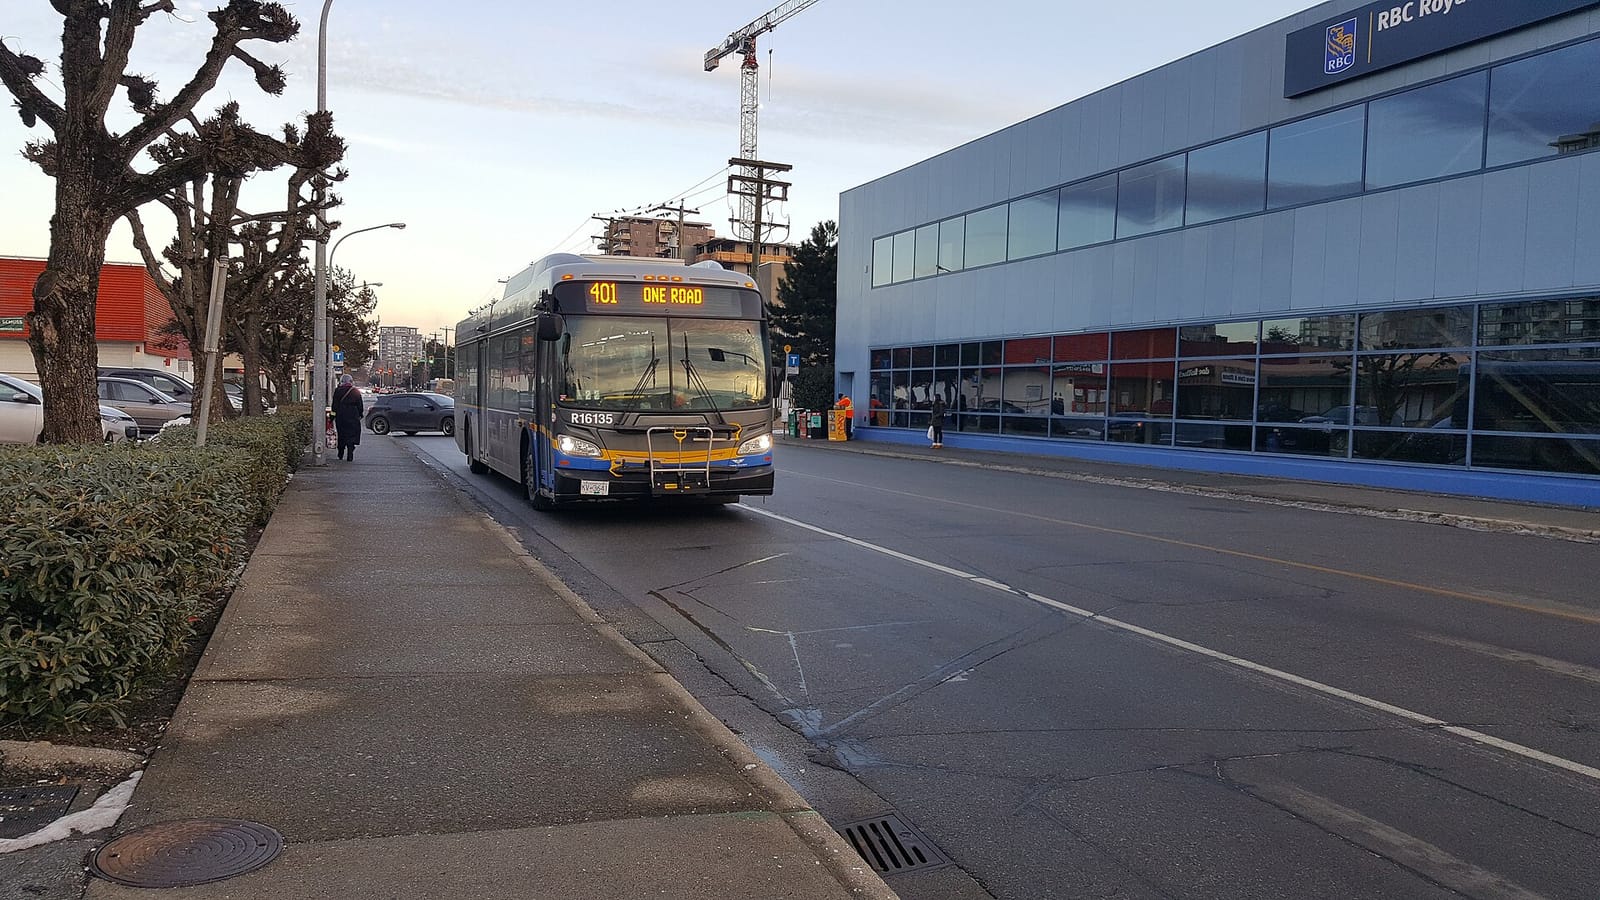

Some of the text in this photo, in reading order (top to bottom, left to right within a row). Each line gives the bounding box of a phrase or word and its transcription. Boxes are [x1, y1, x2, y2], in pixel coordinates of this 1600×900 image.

[1377, 1, 1414, 32] RBC
[1328, 55, 1351, 70] RBC
[590, 282, 702, 304] 401 ONE ROAD
[571, 412, 613, 425] R16135
